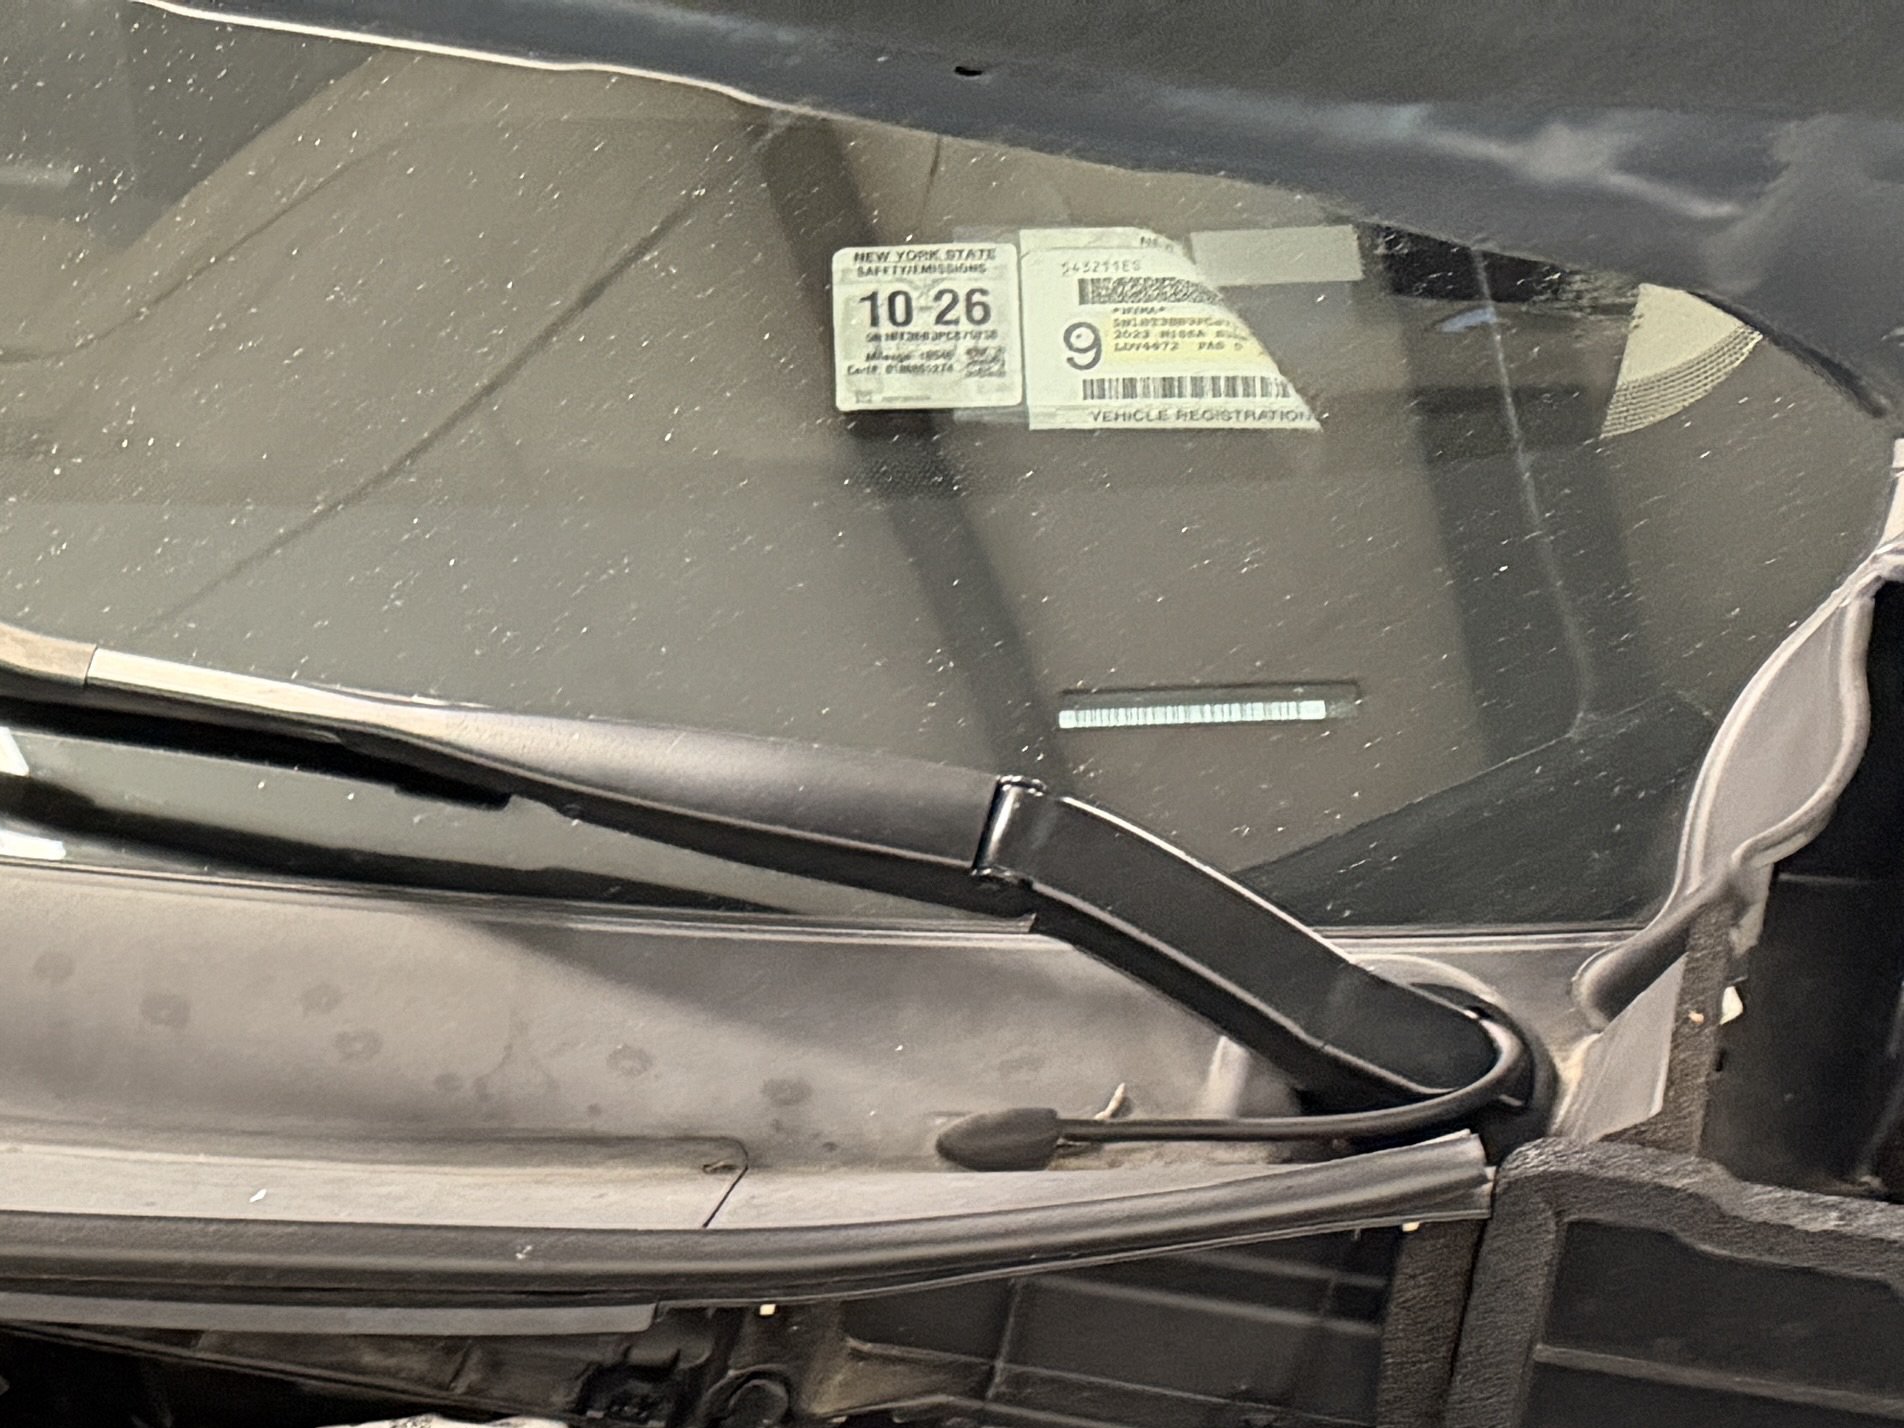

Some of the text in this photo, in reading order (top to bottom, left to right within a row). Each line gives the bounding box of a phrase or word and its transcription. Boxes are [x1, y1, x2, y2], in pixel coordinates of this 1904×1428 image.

[854, 249, 996, 263] NEW YORK STATE
[857, 264, 987, 277] SAFETY/EMISSIONS
[1063, 321, 1102, 370] 9
[1091, 408, 1170, 423] VEHICLE
